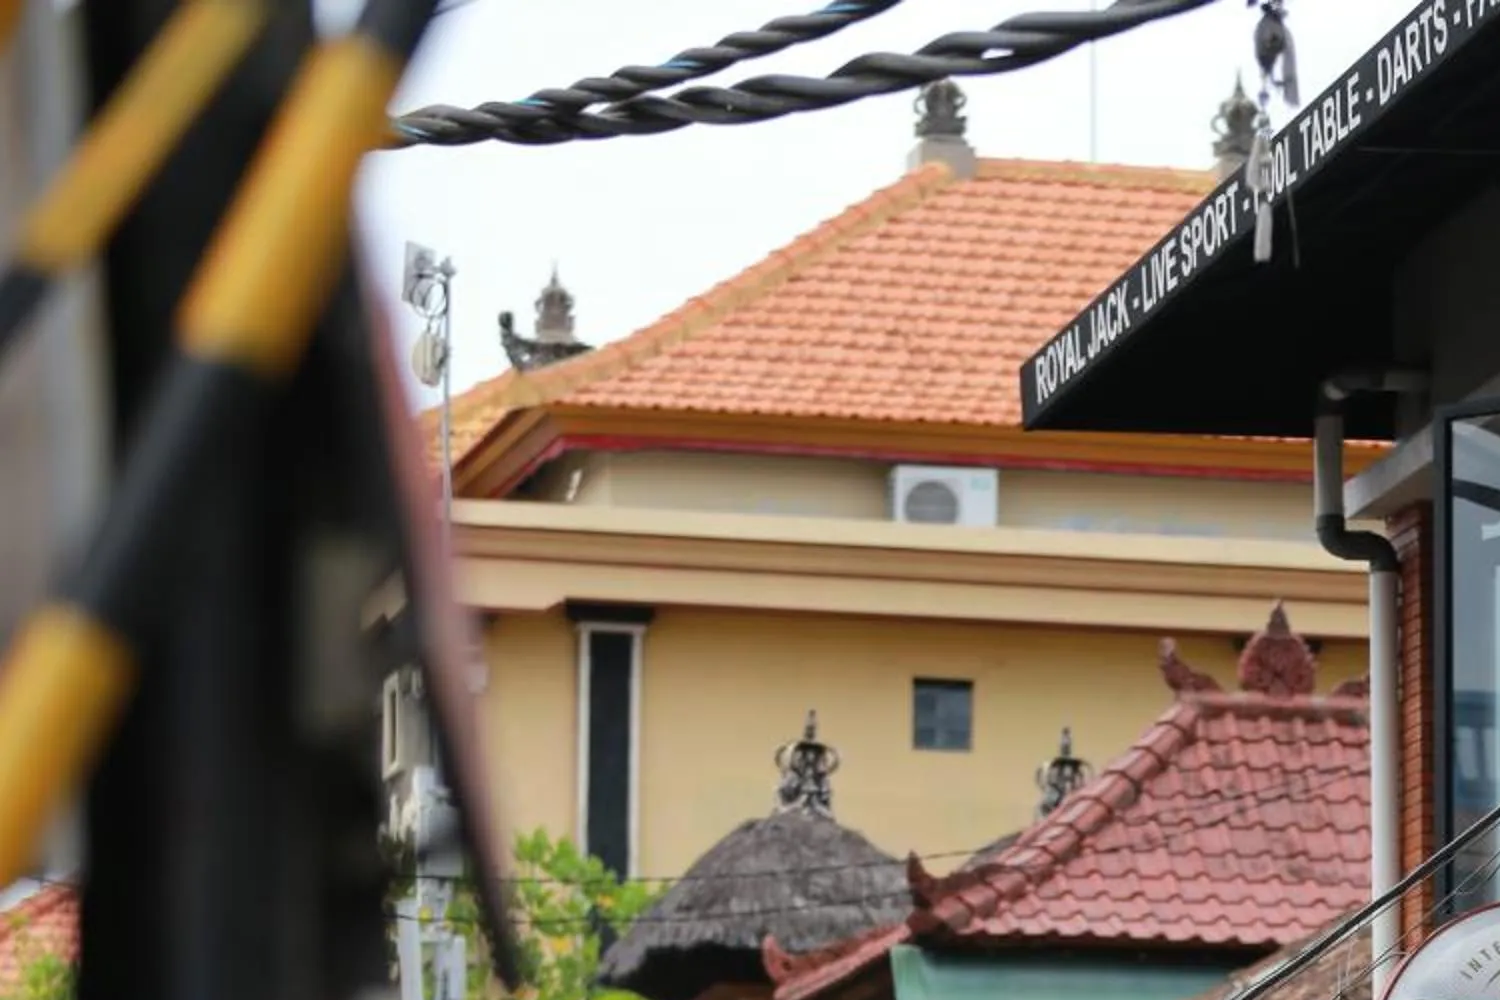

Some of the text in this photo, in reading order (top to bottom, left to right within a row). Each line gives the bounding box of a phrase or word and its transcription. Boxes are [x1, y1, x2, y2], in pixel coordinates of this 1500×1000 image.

[1035, 325, 1087, 404] ROYAL
[1088, 280, 1131, 359] JACK
[1141, 239, 1178, 312] LIVE
[1180, 181, 1239, 277] SPORT
[1254, 136, 1297, 215] OOL
[1300, 71, 1361, 171] TABLE
[1377, 0, 1447, 106] DARTS
